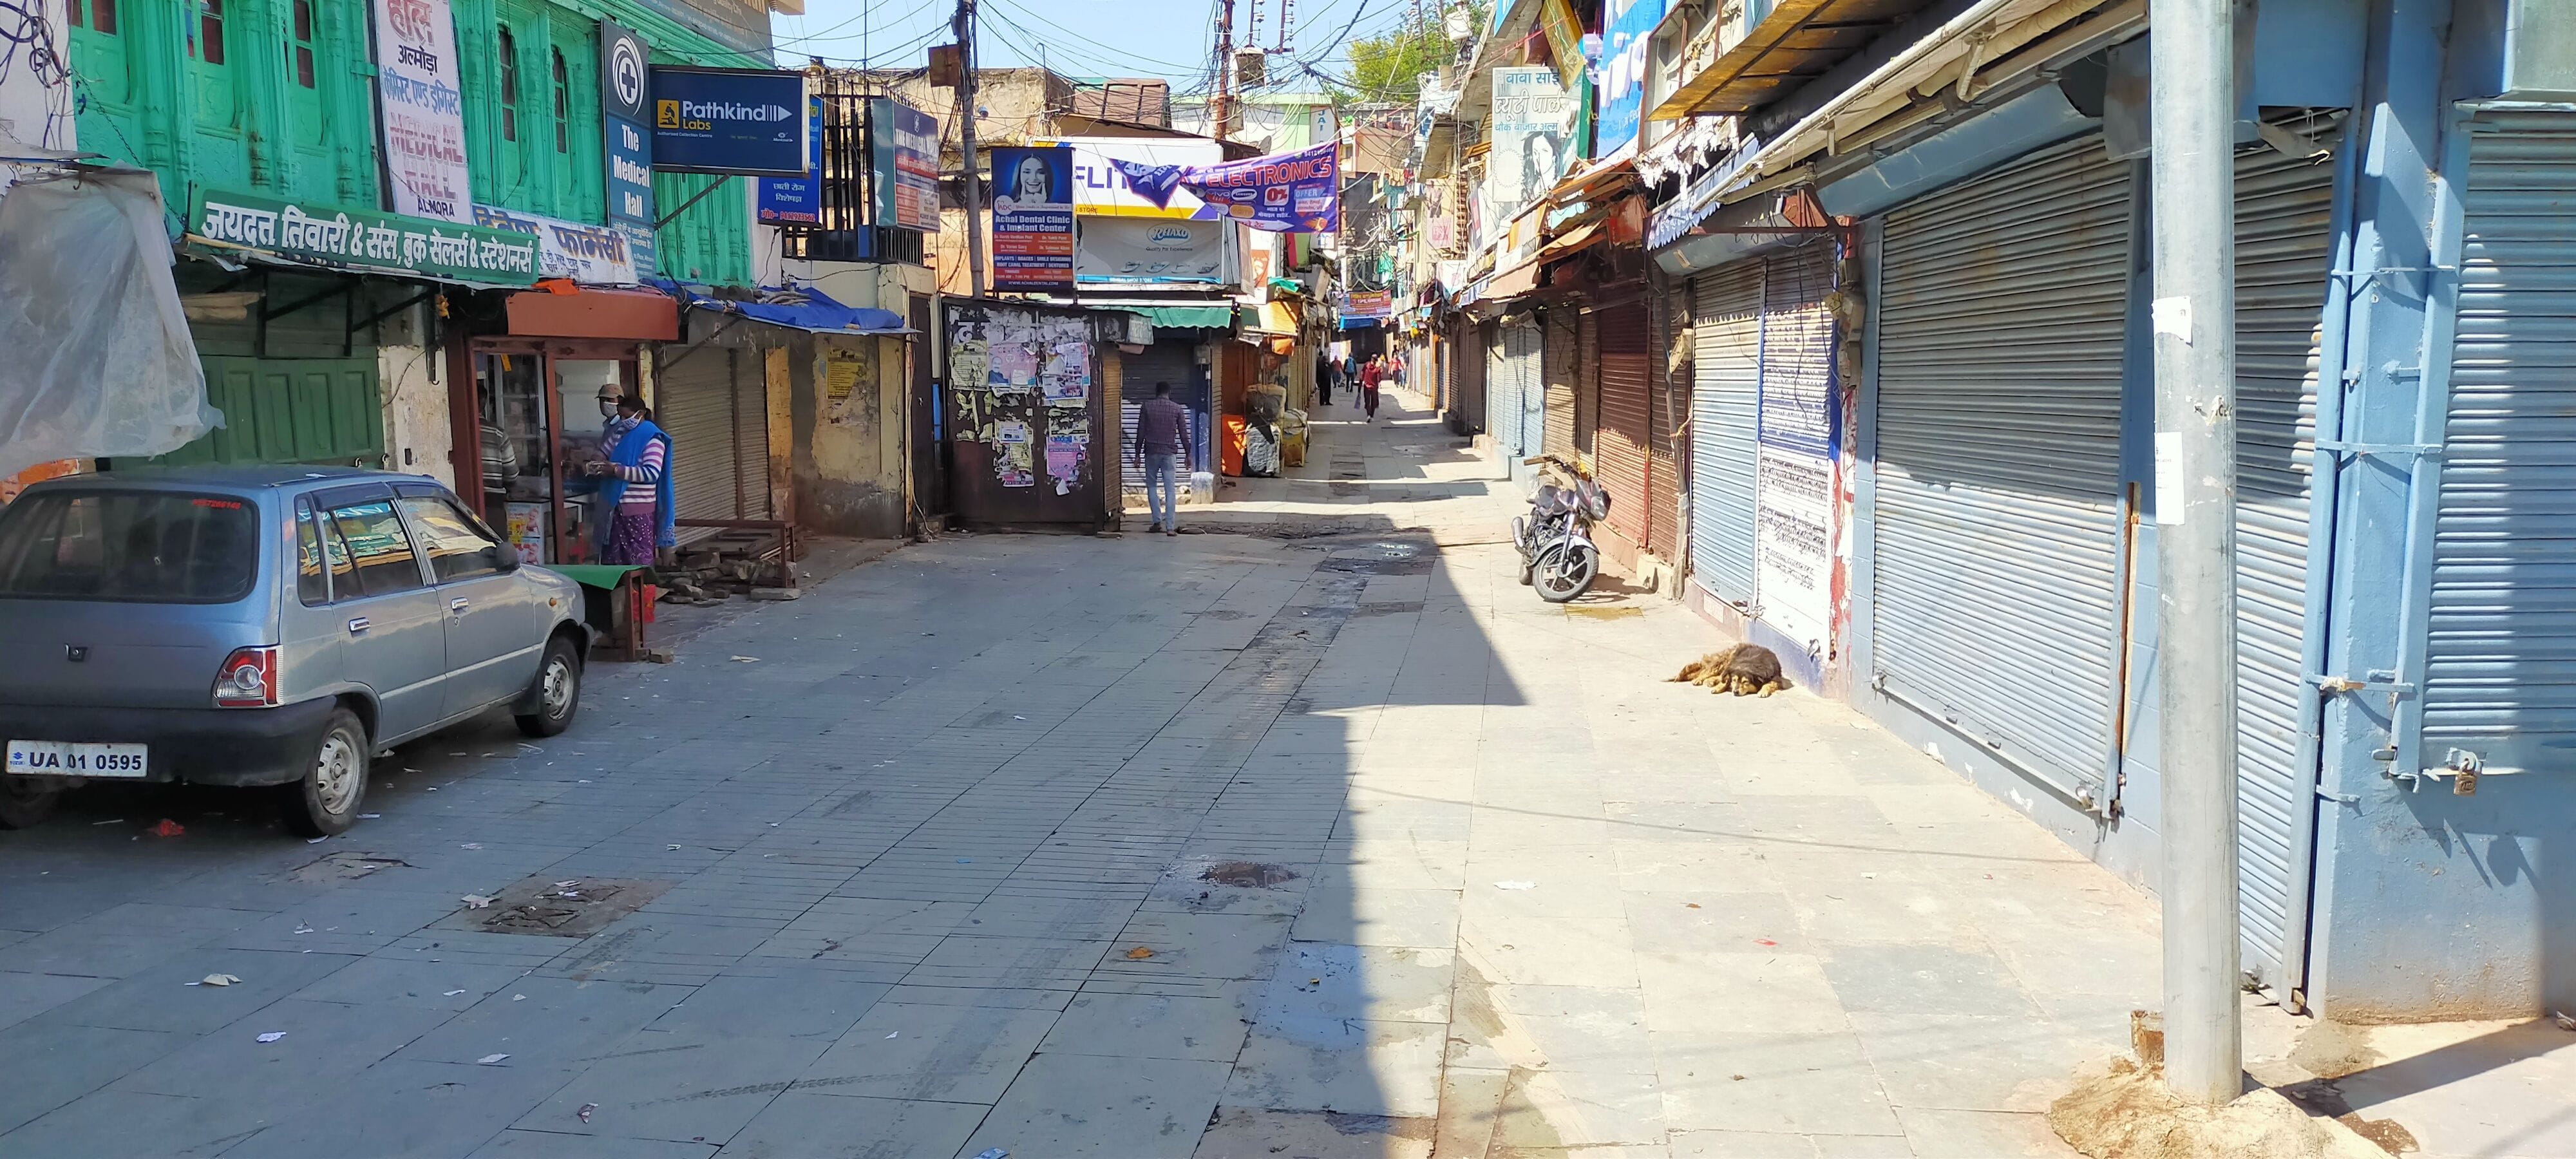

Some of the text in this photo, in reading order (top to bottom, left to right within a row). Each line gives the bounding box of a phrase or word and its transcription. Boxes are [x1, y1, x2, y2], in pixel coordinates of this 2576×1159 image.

[397, 44, 439, 76] अल्मोड़ा
[1506, 72, 1531, 84] बाबा
[683, 100, 766, 121] Pathkind
[683, 119, 711, 130] Labs
[389, 112, 464, 165] MEDICAL
[621, 124, 639, 152] The
[895, 128, 905, 147] THE
[613, 155, 650, 188] Medical
[1206, 156, 1332, 187] ELECTRONICS
[625, 191, 643, 218] Hall
[1267, 186, 1288, 202] 0%
[418, 198, 455, 217] ALMORA
[995, 215, 1018, 223] Achal
[281, 205, 351, 255] तिवारी
[350, 222, 363, 257] &
[404, 232, 426, 269] बुक
[430, 227, 468, 267] सेलर्स
[469, 237, 479, 269] &
[480, 236, 533, 273] स्टेशनर्स
[30, 752, 142, 770] UA 01 0595
